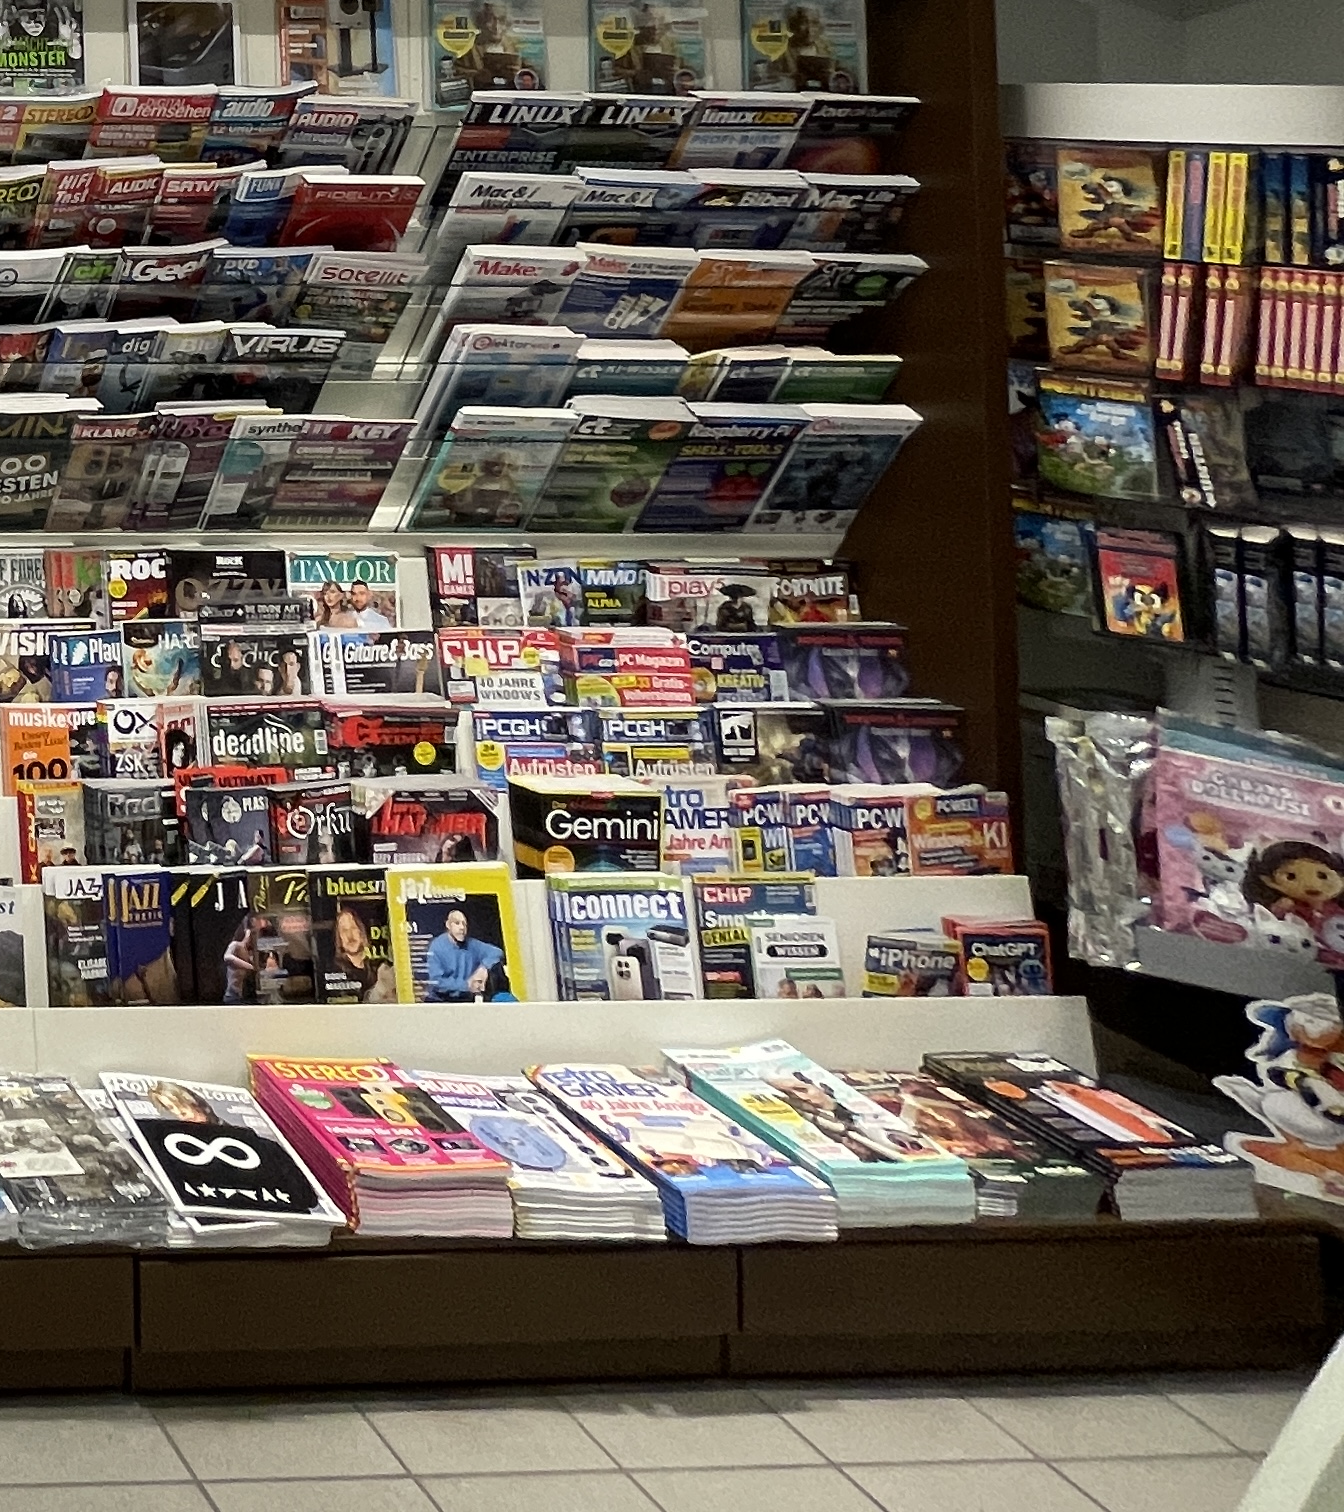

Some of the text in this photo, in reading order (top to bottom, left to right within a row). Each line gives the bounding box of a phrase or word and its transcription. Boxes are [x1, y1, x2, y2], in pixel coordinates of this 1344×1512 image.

[135, 105, 211, 119] fernsehen
[296, 114, 358, 127] AUDIO
[489, 105, 576, 123] LINUX
[474, 261, 541, 277] Make:
[234, 336, 341, 355] VIRUS
[293, 559, 392, 584] TAYLOR
[442, 640, 520, 666] CHIP
[213, 727, 304, 756] deadline
[508, 758, 596, 776] Aufrüsten
[546, 809, 658, 840] Gemini
[704, 887, 750, 902] CHIP
[571, 892, 682, 919] connect
[970, 943, 1037, 956] ChatGPT
[880, 950, 957, 970] iPhone
